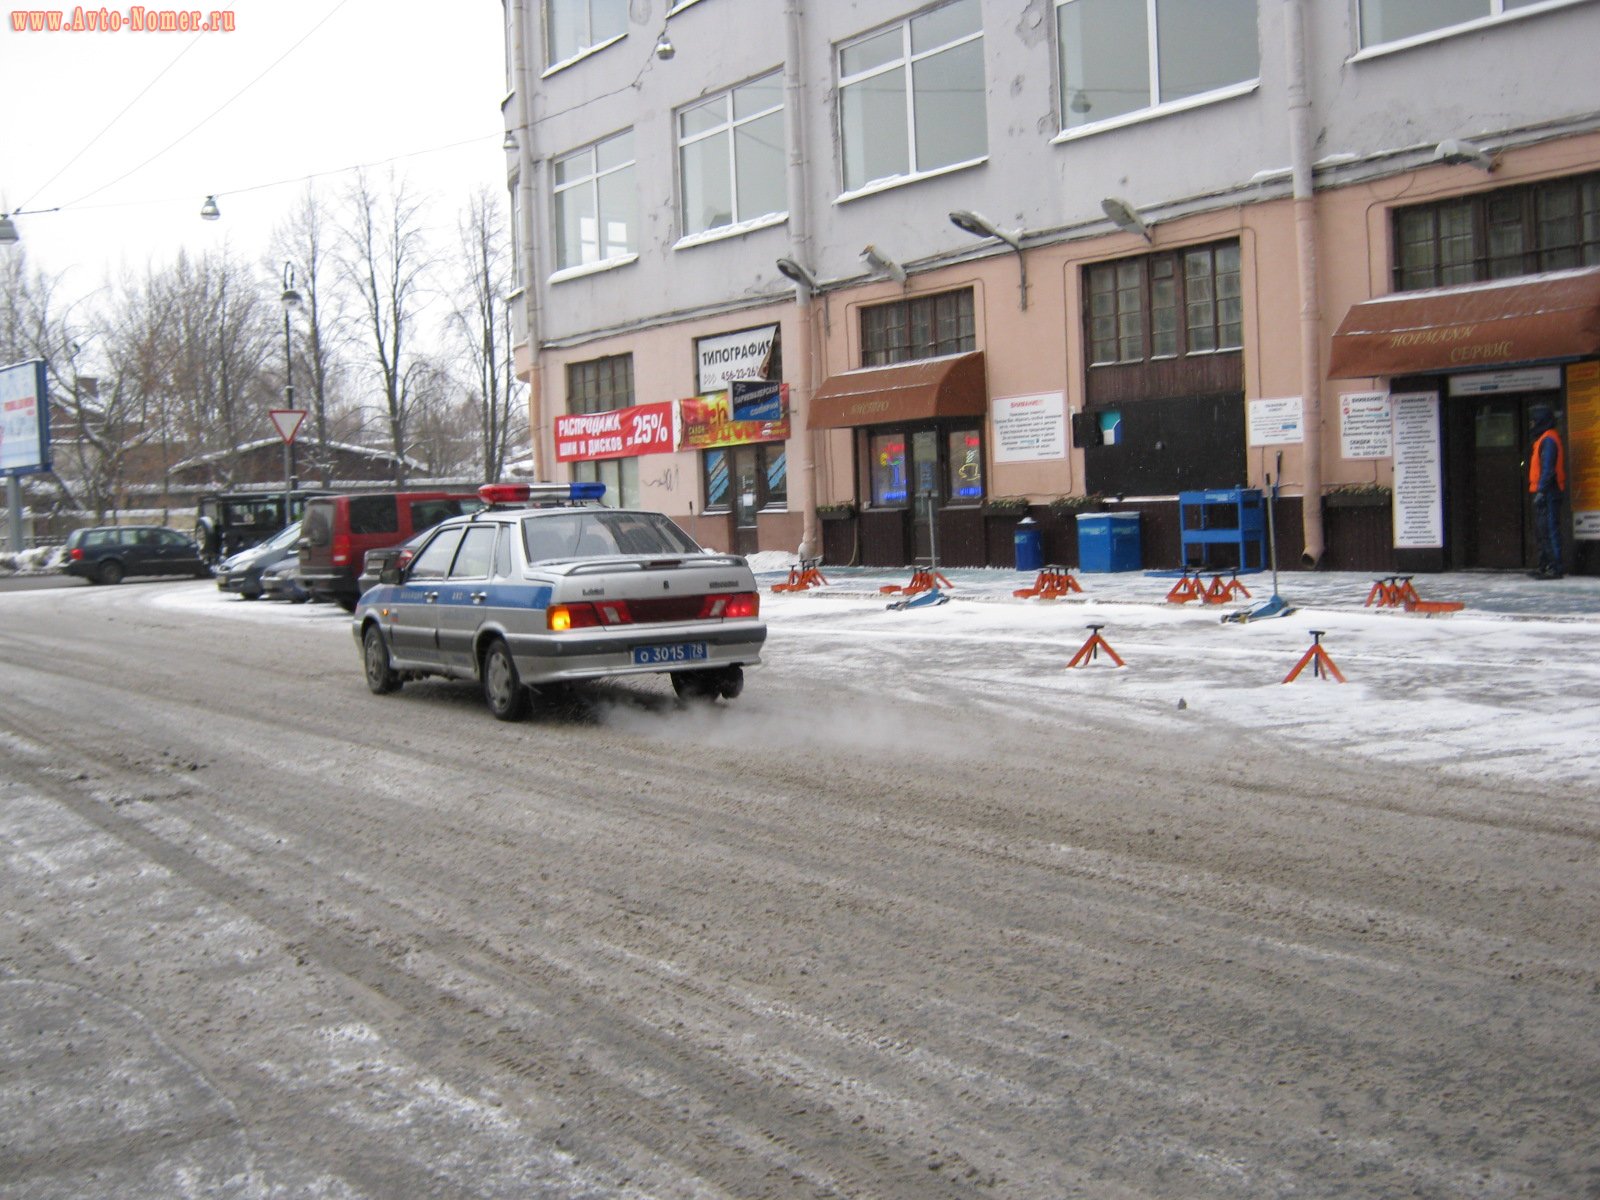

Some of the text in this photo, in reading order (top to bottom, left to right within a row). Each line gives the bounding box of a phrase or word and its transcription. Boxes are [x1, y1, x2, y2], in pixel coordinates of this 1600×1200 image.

[558, 413, 622, 437] РАСПРОДАЖА
[633, 412, 668, 446] 25%
[580, 440, 587, 454] И
[588, 436, 623, 456] ДИСКОВ
[654, 644, 685, 661] 3015
